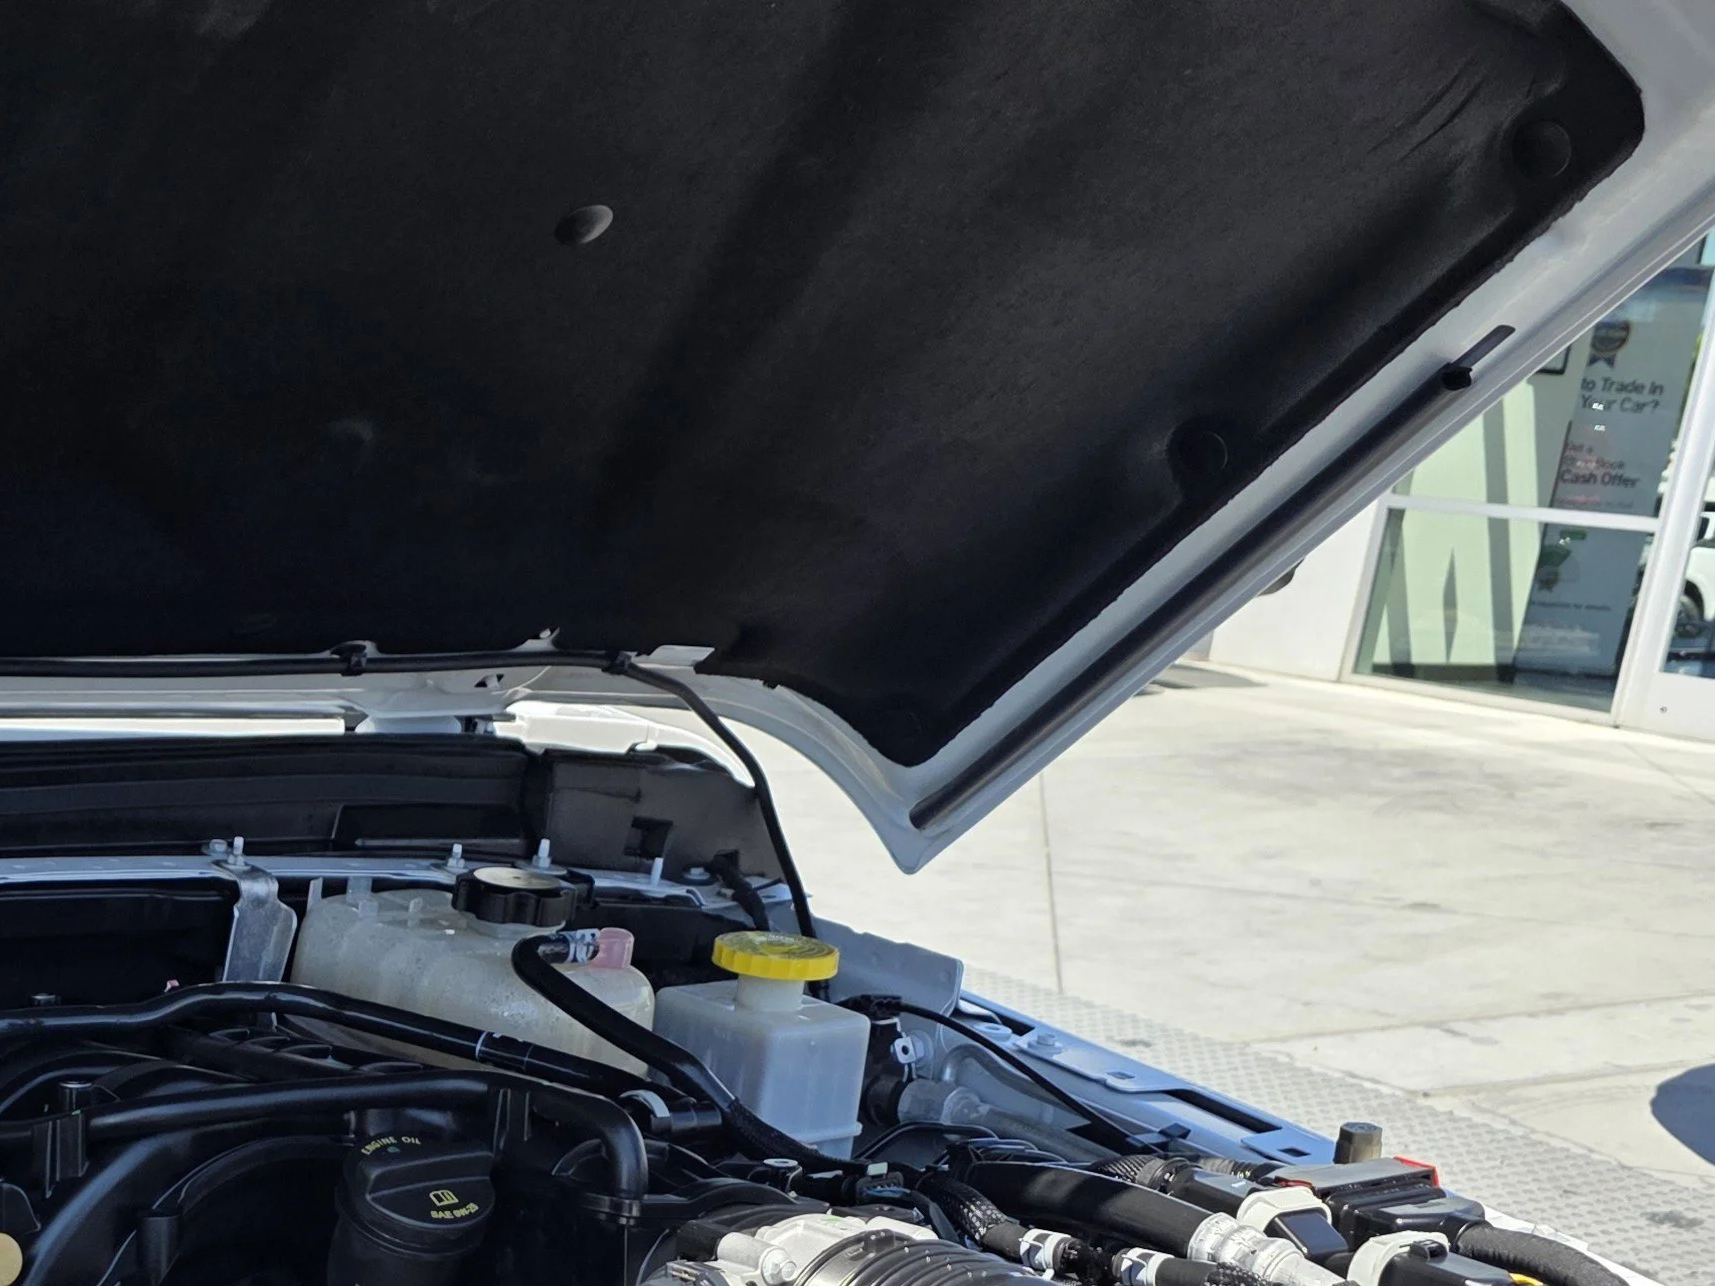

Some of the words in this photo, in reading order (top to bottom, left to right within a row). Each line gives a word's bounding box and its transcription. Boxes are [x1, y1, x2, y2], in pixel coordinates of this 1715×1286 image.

[1581, 377, 1596, 391] to
[1601, 376, 1646, 394] Trade
[1648, 381, 1665, 396] In
[1620, 396, 1660, 413] Car?
[1561, 469, 1597, 484] Cash
[1601, 471, 1642, 488] Offer
[361, 1136, 398, 1156] ENGINE
[401, 1136, 422, 1145] OIL
